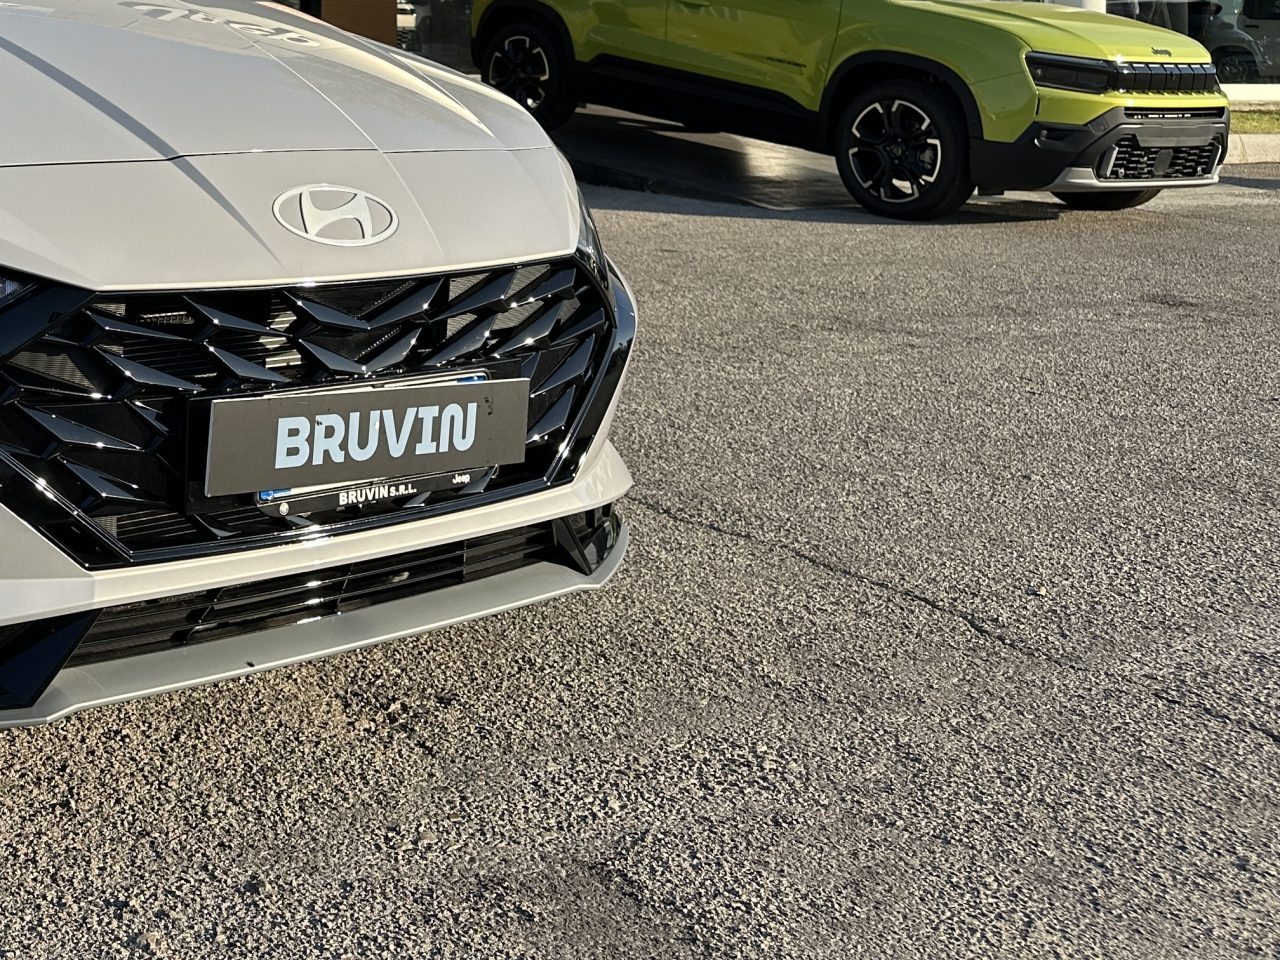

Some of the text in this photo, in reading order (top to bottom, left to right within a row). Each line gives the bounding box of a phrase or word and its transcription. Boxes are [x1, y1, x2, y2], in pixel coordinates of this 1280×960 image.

[275, 402, 478, 469] BRUVIN
[452, 473, 470, 484] Jeep
[339, 483, 417, 506] BRUVIN S.R.L.
